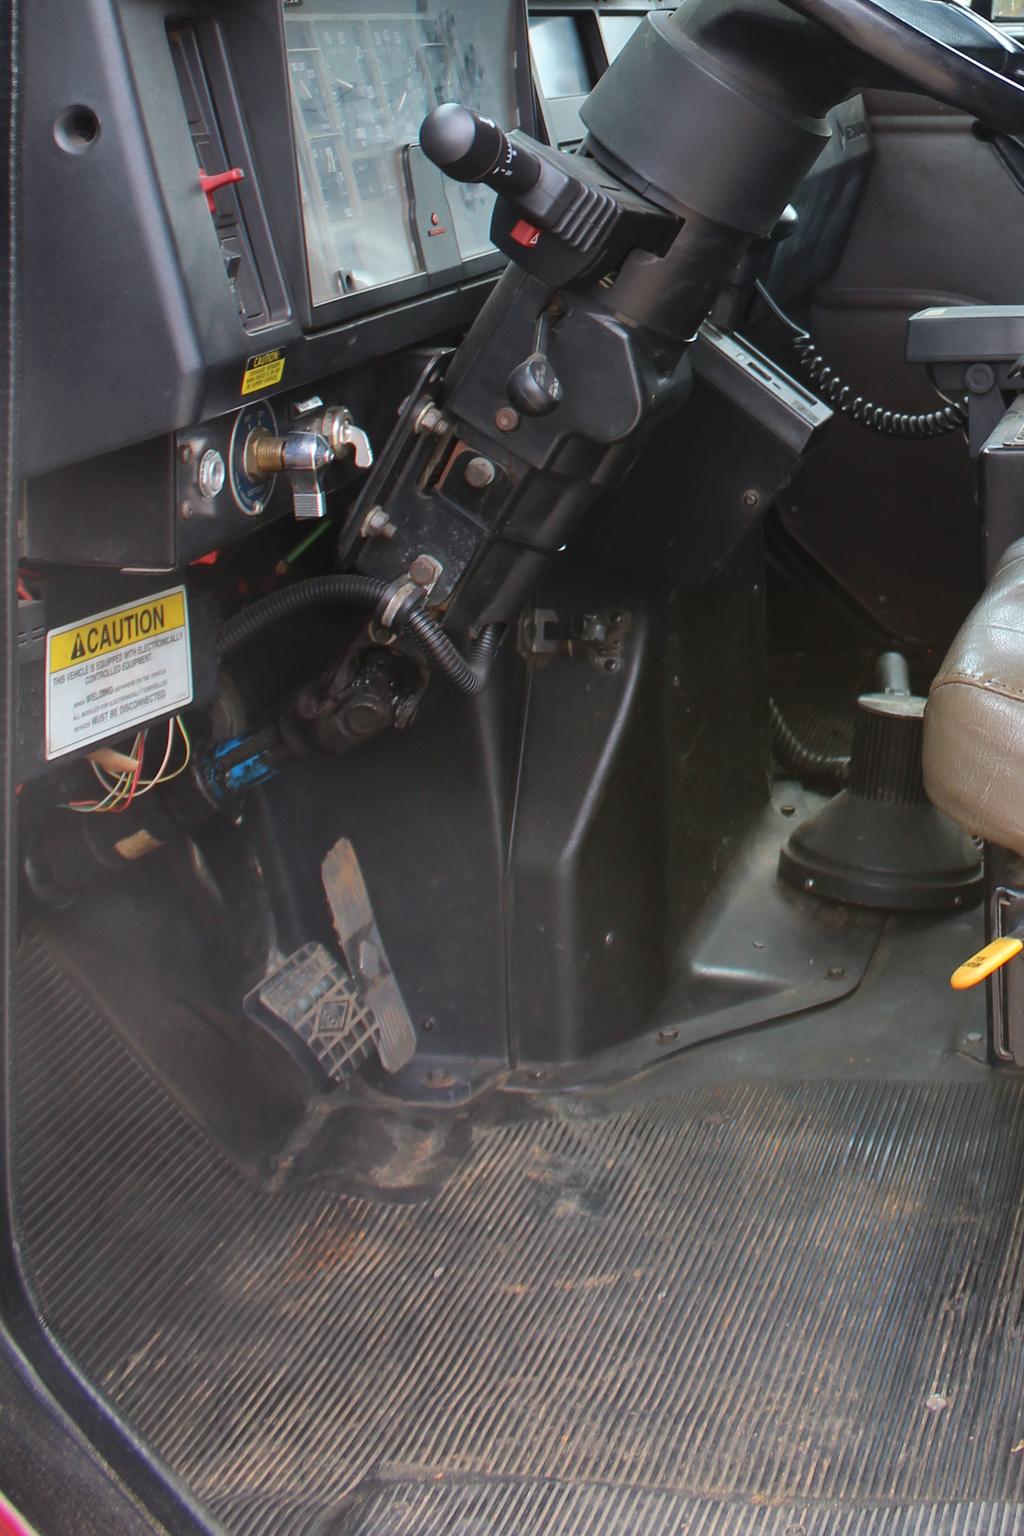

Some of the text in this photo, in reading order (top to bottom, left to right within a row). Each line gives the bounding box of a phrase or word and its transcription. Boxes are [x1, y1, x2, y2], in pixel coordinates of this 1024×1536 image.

[87, 604, 164, 654] CAUTION
[53, 674, 65, 686] THIS
[67, 666, 88, 680] VEHICLE
[97, 653, 122, 670] EQUIPPED
[124, 648, 136, 660] WITH
[138, 631, 182, 654] ELECTRONICALLY
[86, 664, 120, 685] CONTROLLED
[87, 686, 113, 703] WELDING
[92, 711, 108, 725] MUST
[110, 708, 117, 718] BE
